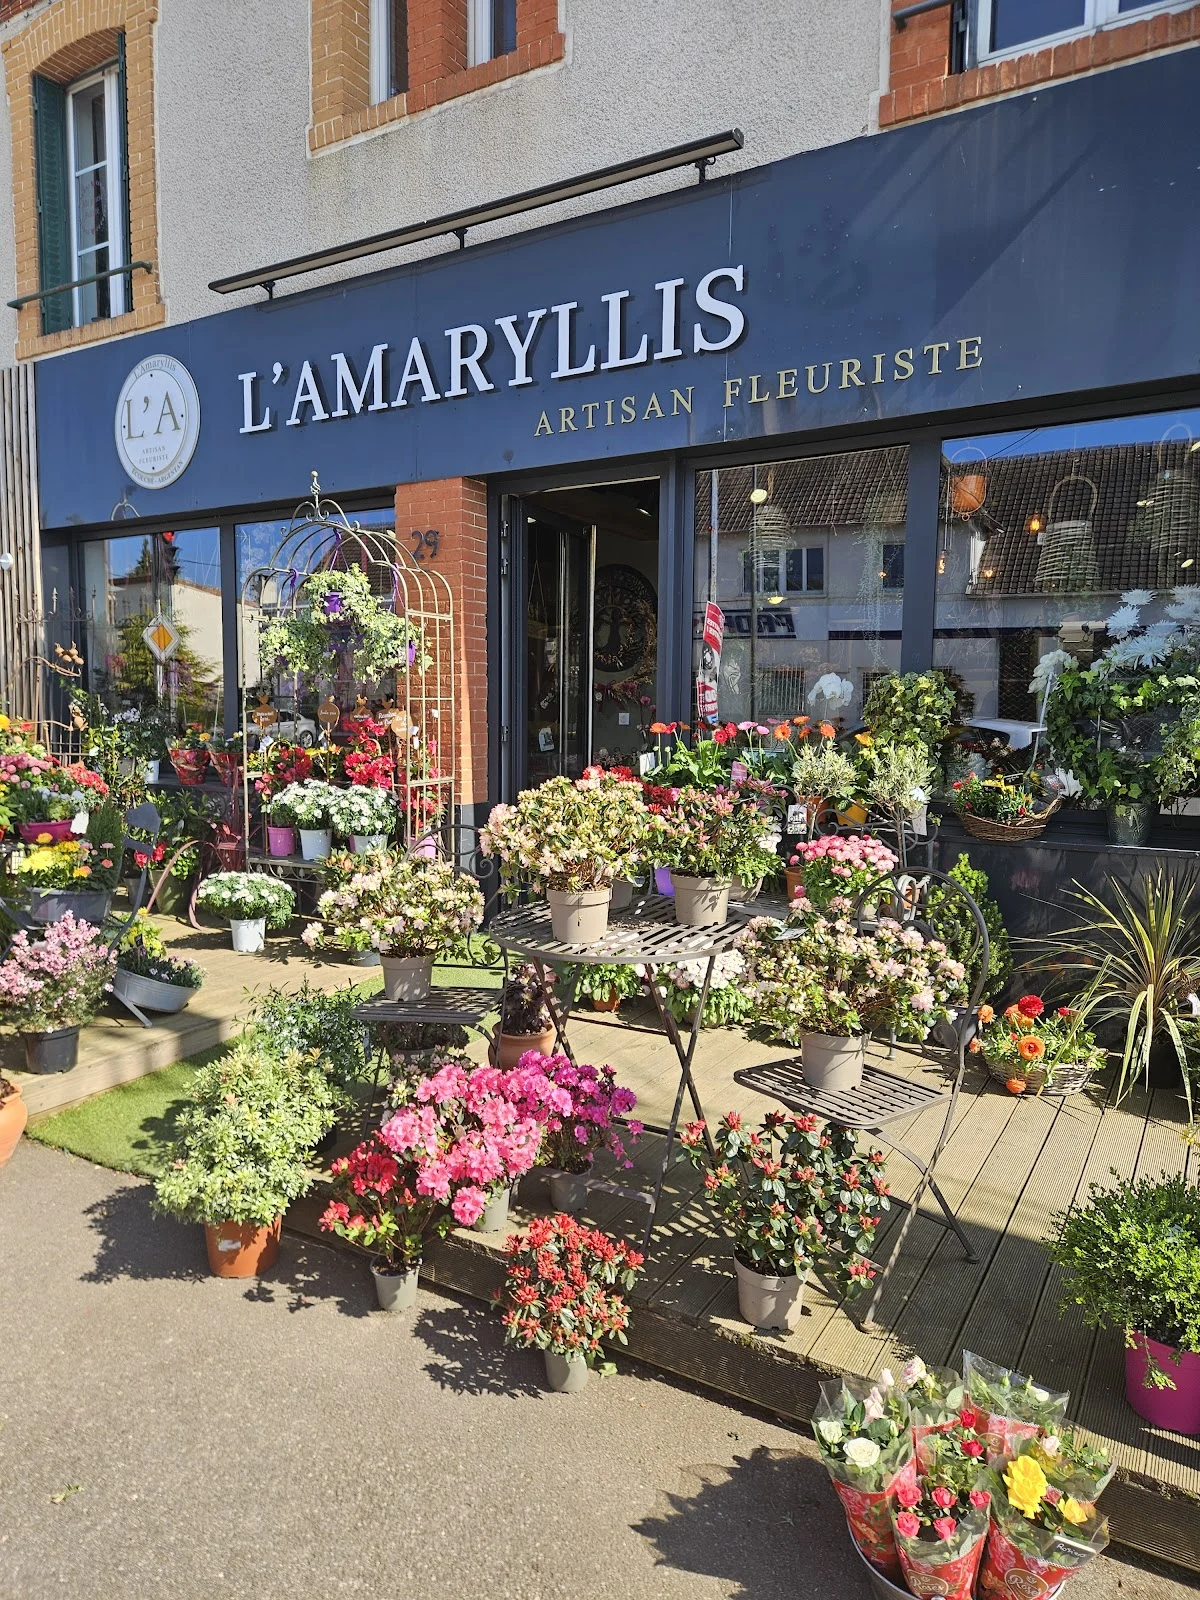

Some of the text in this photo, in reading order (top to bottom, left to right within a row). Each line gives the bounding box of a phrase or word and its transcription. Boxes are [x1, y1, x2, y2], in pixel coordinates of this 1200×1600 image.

[238, 264, 746, 434] L'AMARYLLIS
[533, 336, 984, 438] ARTISAN FLEURISTE
[139, 453, 169, 464] FLEURISTE
[141, 445, 166, 455] ARTISAN
[411, 529, 439, 560] 29
